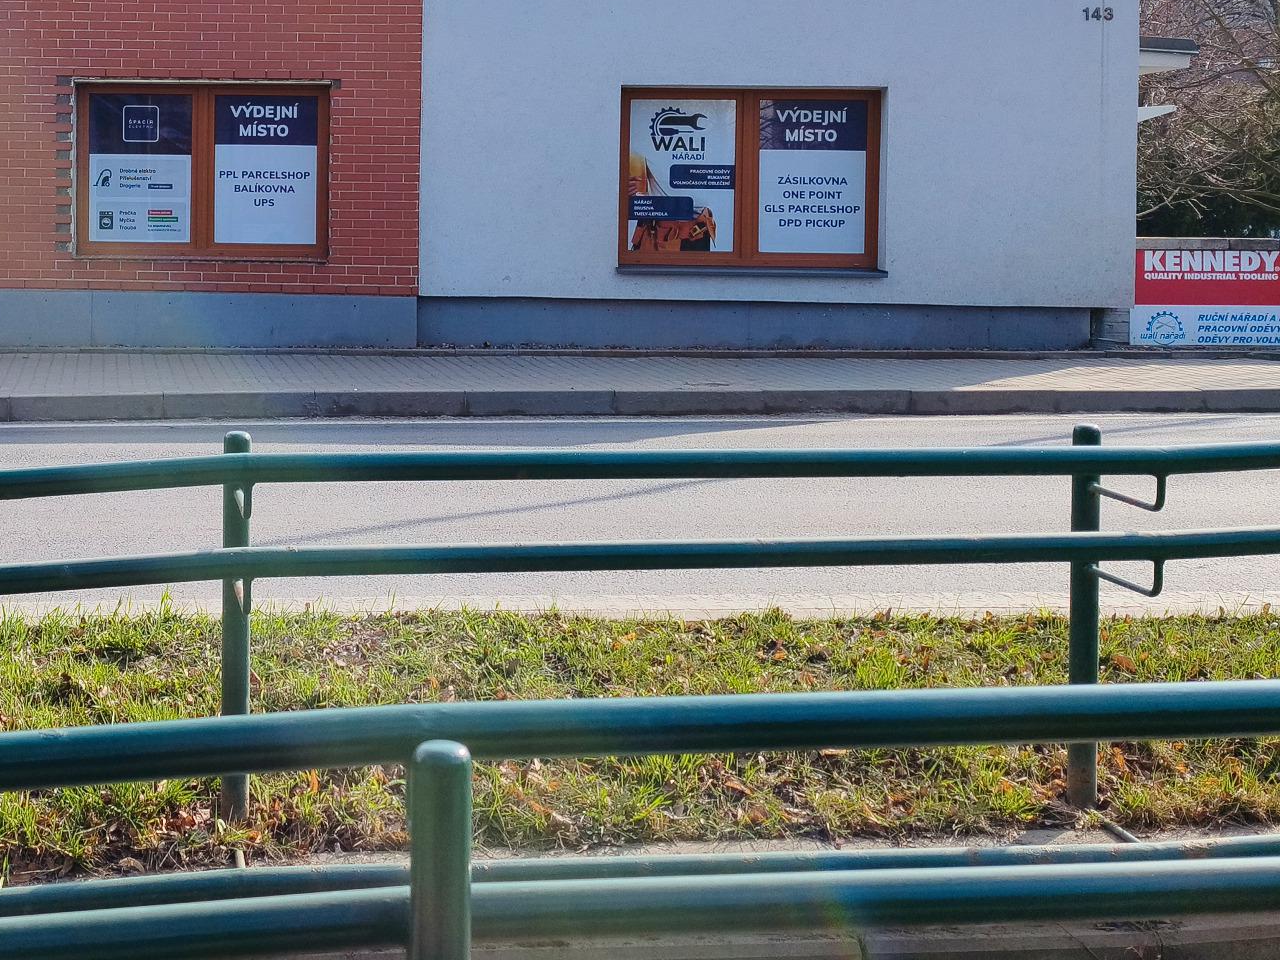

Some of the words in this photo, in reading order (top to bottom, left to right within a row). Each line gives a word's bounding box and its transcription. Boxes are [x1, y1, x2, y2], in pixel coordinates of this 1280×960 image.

[1082, 7, 1114, 21] 143
[230, 102, 300, 121] VÝDEJNÍ
[776, 106, 848, 126] VÝDEJNÍ
[239, 121, 289, 137] MÍSTO
[785, 126, 838, 142] MÍSTO
[651, 136, 706, 152] WALI
[672, 152, 705, 161] NÁŘADÍ
[219, 171, 239, 179] PPL
[241, 171, 311, 180] PARCELSHOP
[778, 174, 848, 186] ZÁSILKOVNA
[234, 182, 295, 193] BALÍKOVNA
[783, 190, 806, 199] ONE
[808, 191, 842, 200] POINT
[253, 198, 275, 207] UPS
[764, 204, 785, 213] GLS
[788, 204, 861, 214] PARCELSHOP
[779, 219, 802, 227] DPD
[805, 219, 846, 228] PICKUP
[1144, 272, 1183, 280] QUALITY
[1198, 312, 1229, 322] RUČNÍ
[1230, 312, 1269, 322] NÁŘADÍ
[1269, 314, 1276, 322] A
[1198, 323, 1249, 333] PRACOVNÍ
[1197, 334, 1231, 344] ODĚVY
[1232, 336, 1253, 344] PRO
